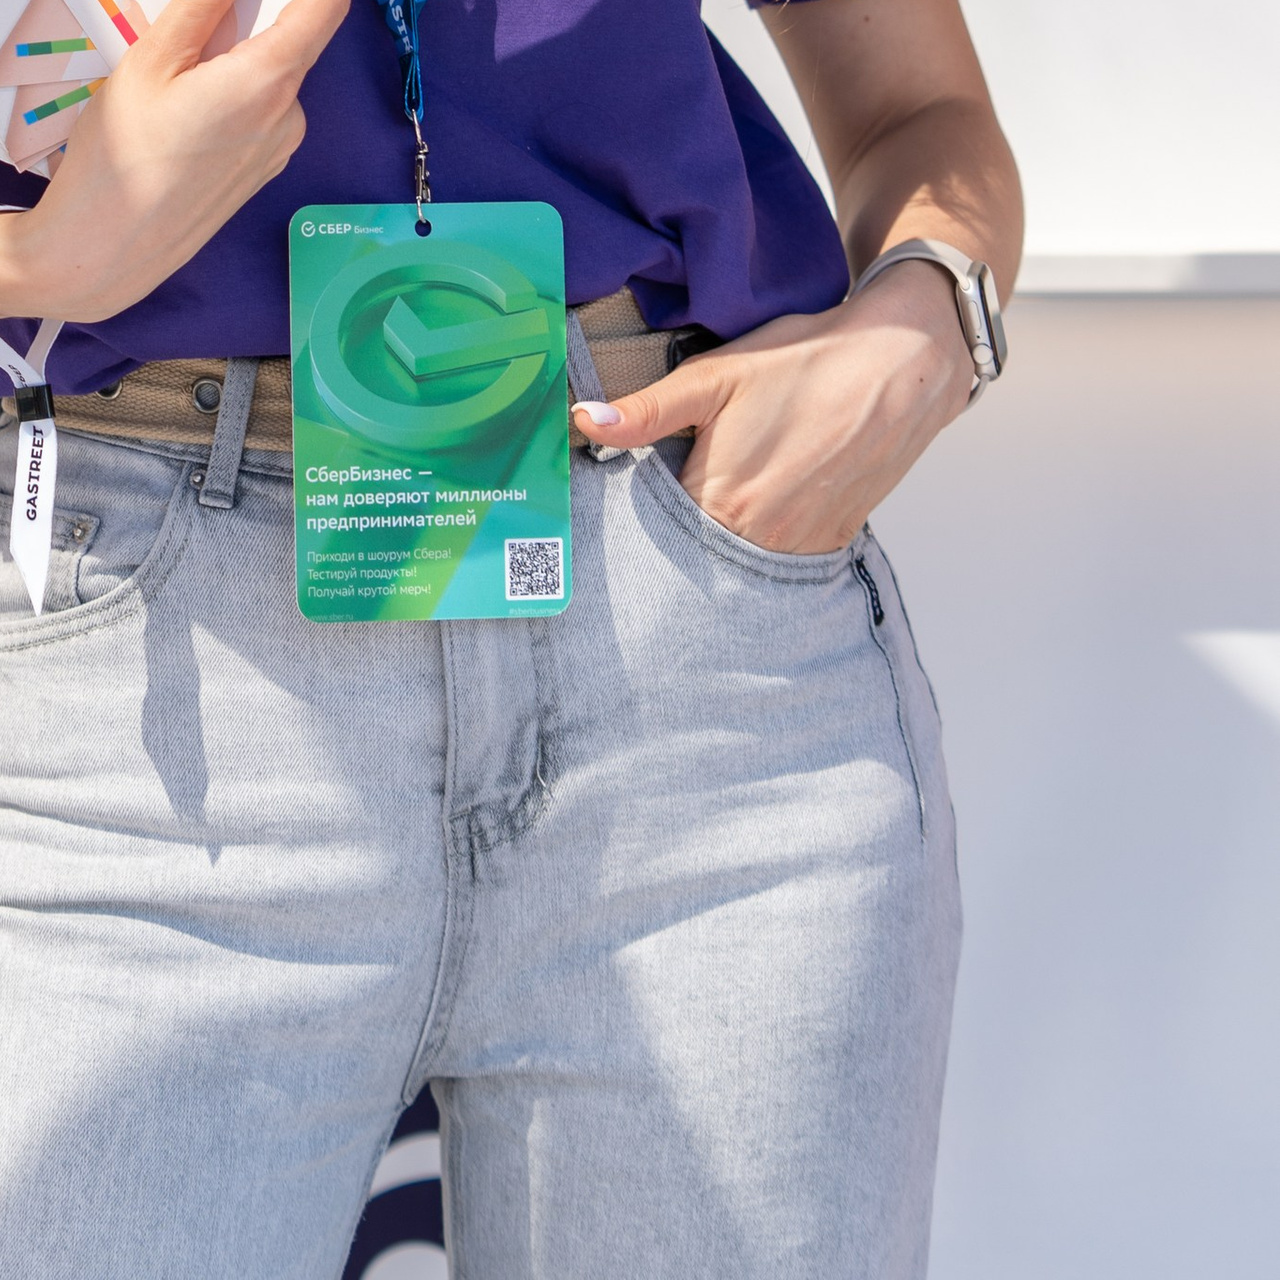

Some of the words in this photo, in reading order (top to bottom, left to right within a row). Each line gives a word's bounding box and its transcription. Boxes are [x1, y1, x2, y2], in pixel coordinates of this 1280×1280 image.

[319, 224, 351, 234] СБЕР
[26, 424, 44, 521] GASTREET
[306, 466, 412, 485] СберБизнес
[306, 494, 338, 506] нам
[343, 491, 430, 508] доверяют
[436, 489, 527, 503] миллионы
[307, 509, 476, 533] предпринимателей
[307, 551, 355, 563] Приходи
[368, 552, 411, 563] шоурум
[414, 548, 452, 559] Сбера!
[307, 567, 356, 582] Тестируй
[360, 567, 417, 580] продукты!
[308, 586, 355, 598] Получай
[358, 584, 396, 598] крутой
[400, 584, 431, 597] мерч!
